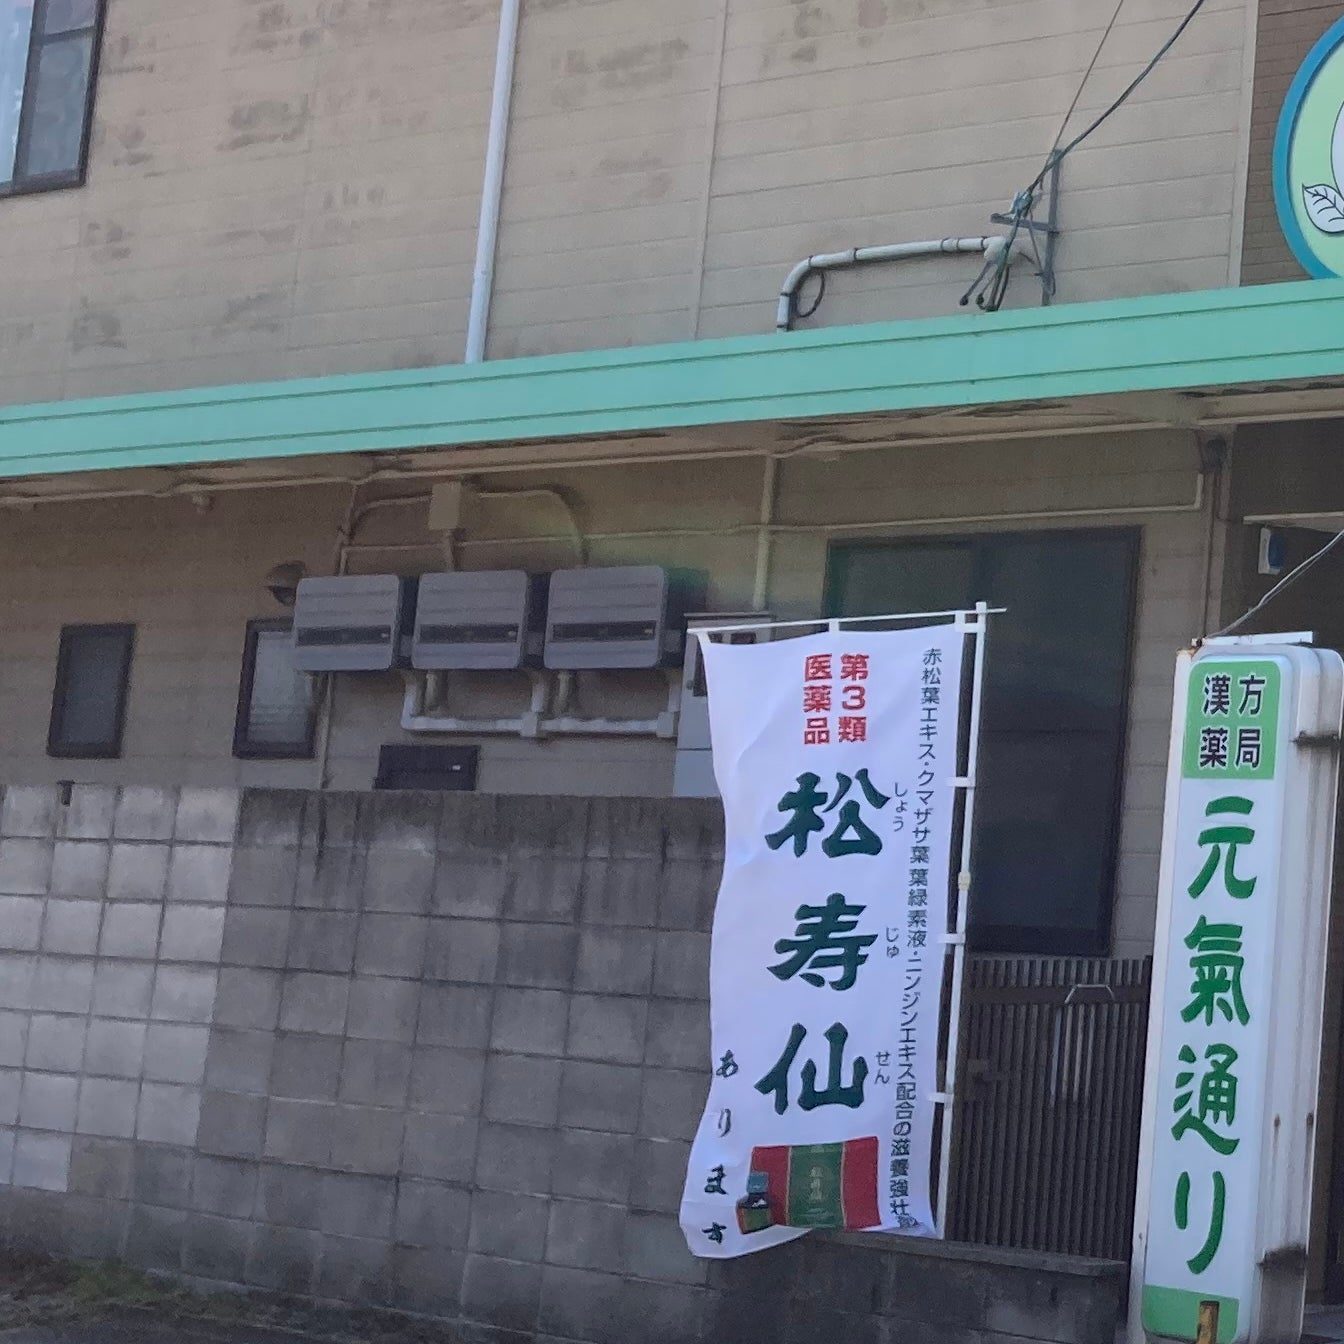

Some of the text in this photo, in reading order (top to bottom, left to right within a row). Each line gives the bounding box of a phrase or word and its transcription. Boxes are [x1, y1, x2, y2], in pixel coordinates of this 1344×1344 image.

[803, 653, 832, 744] 医薬品
[839, 653, 869, 743] 第3類
[1202, 675, 1265, 716] 漢方
[1200, 729, 1262, 770] 薬局
[892, 782, 907, 832] しょう
[754, 768, 891, 1115] 松寿仙
[885, 927, 899, 958] じゅ
[875, 1051, 890, 1085] せん
[1171, 796, 1258, 1274] 元氣通り
[702, 1049, 739, 1244] あります
